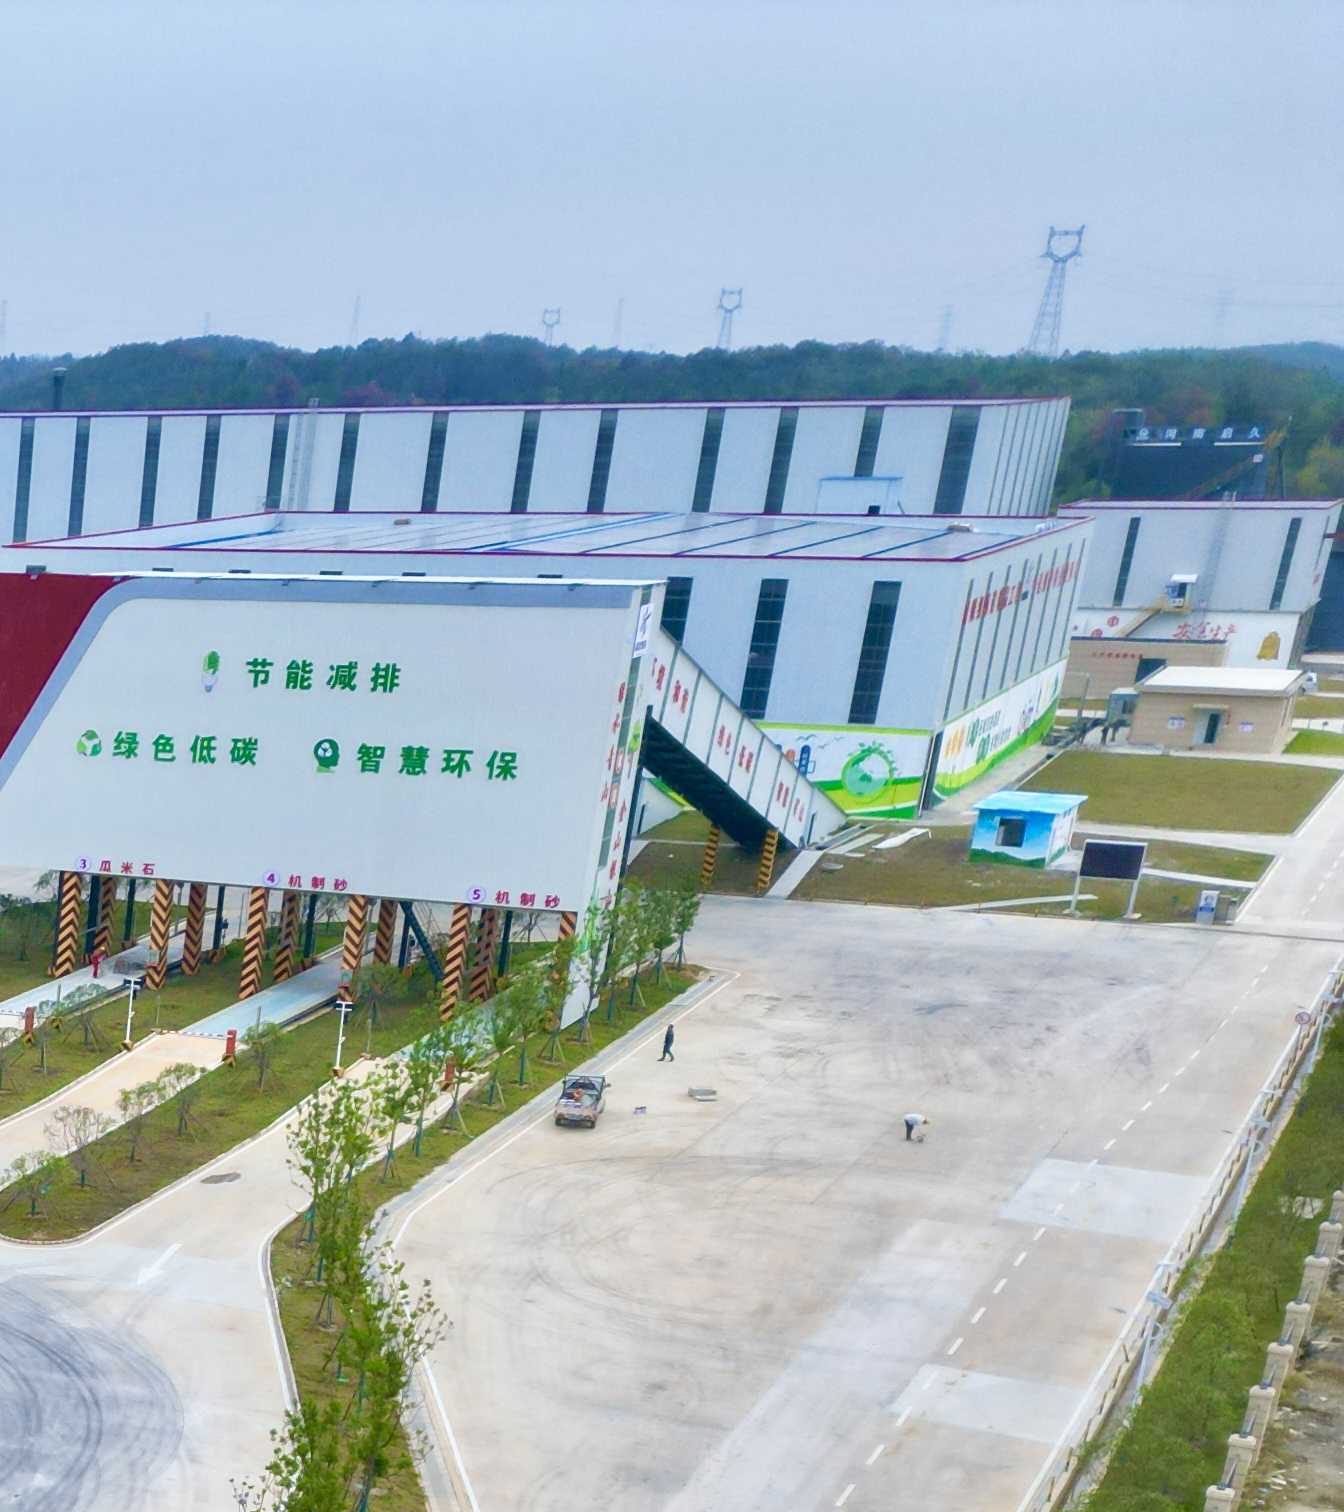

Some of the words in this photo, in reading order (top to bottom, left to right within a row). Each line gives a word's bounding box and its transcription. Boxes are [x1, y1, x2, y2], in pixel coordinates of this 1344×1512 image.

[245, 658, 402, 693] 节能减排
[112, 730, 259, 766] 绿色低碳
[356, 743, 520, 781] 智慧环保
